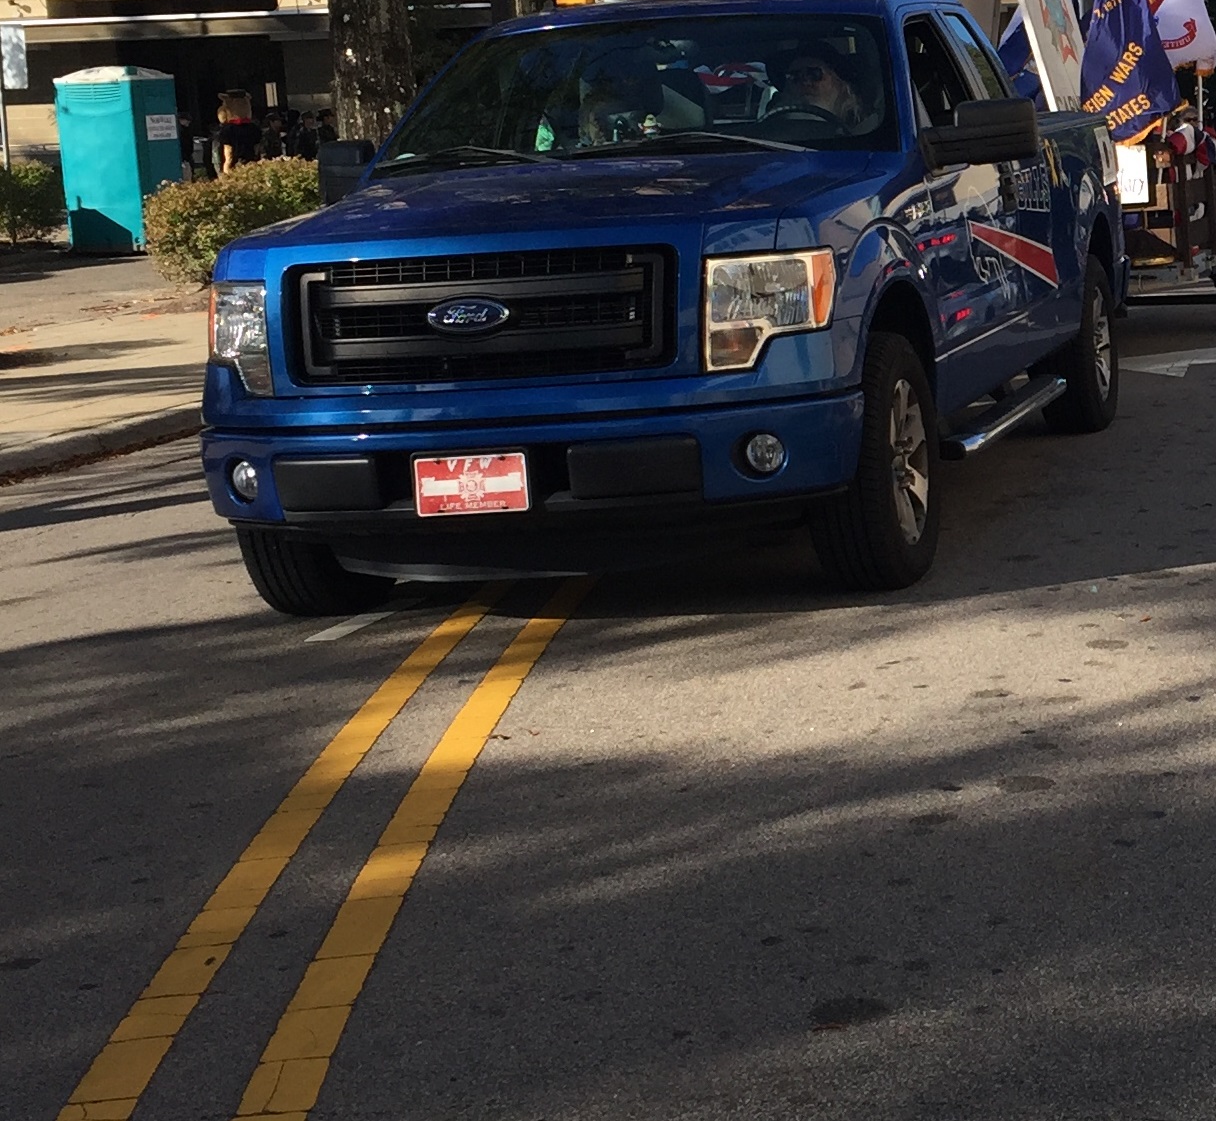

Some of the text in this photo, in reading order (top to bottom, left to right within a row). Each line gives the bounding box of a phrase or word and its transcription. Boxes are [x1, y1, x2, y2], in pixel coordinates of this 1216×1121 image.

[1110, 41, 1143, 84] WARS
[1106, 94, 1151, 130] STATES
[443, 305, 488, 323] Ford
[440, 500, 507, 511] LIFE MEMBER
